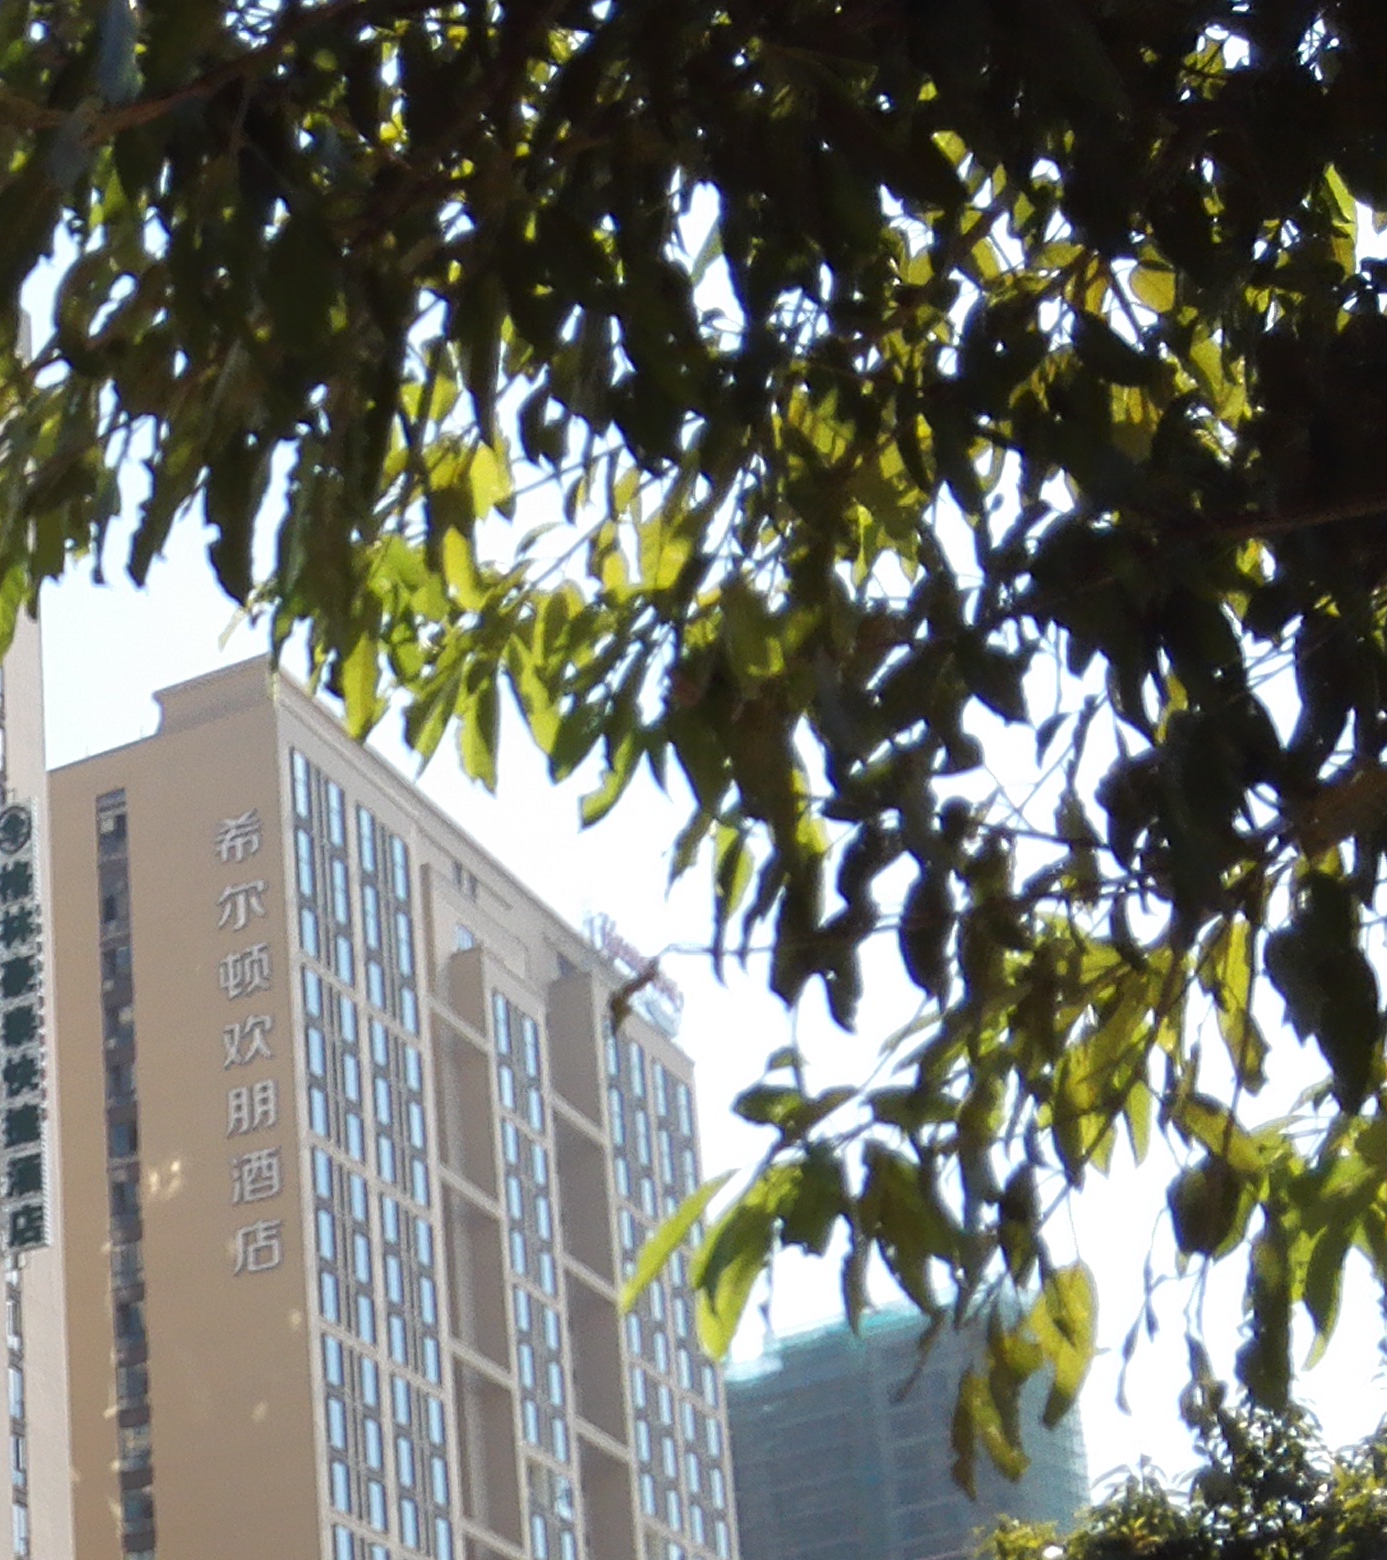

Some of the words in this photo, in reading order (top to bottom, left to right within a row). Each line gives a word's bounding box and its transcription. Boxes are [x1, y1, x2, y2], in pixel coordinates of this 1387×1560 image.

[215, 808, 285, 1276] 希尔顿欢朋酒店
